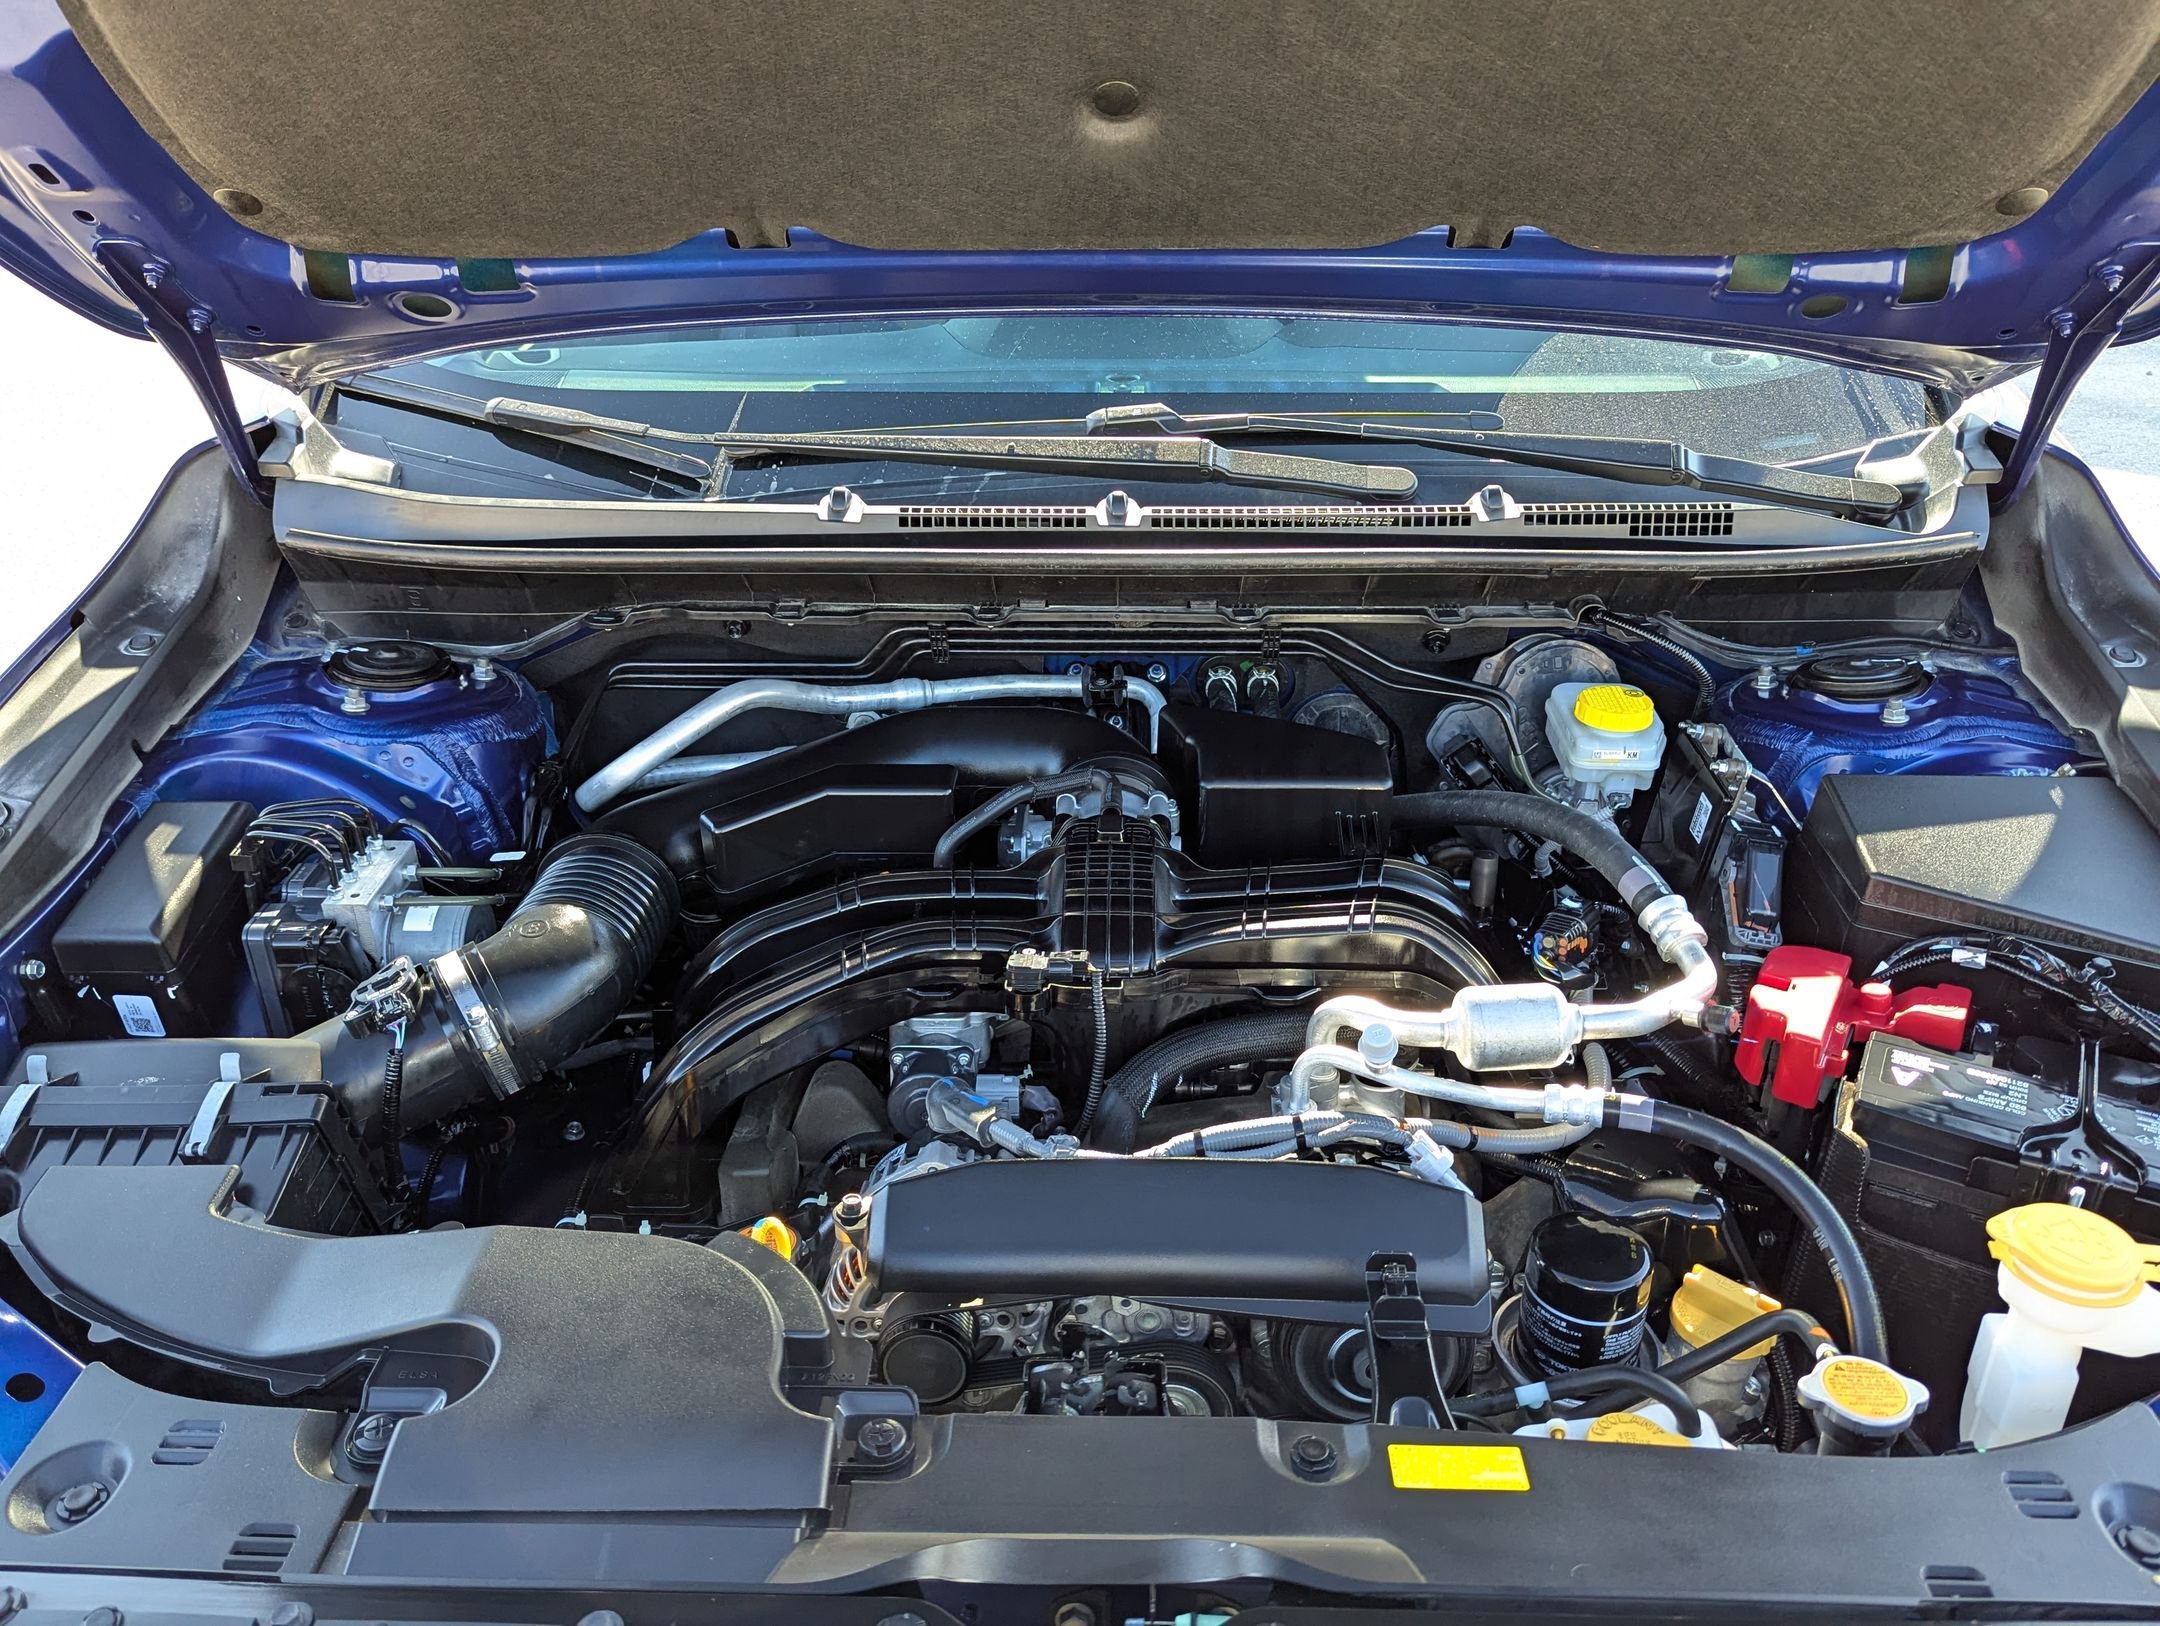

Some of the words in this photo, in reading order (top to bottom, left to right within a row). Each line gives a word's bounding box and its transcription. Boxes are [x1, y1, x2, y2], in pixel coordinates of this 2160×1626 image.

[1942, 1090, 1964, 1100] AMPS
[1983, 1089, 2000, 1097] SIZE
[2008, 1090, 2028, 1100] LN2
[1965, 1096, 2004, 1110] CRANKING
[1977, 1094, 2007, 1105] AMPS
[2001, 1095, 2027, 1104] GROUP
[2005, 1106, 2027, 1116] COLD
[1591, 1413, 1664, 1435] COOLANT
